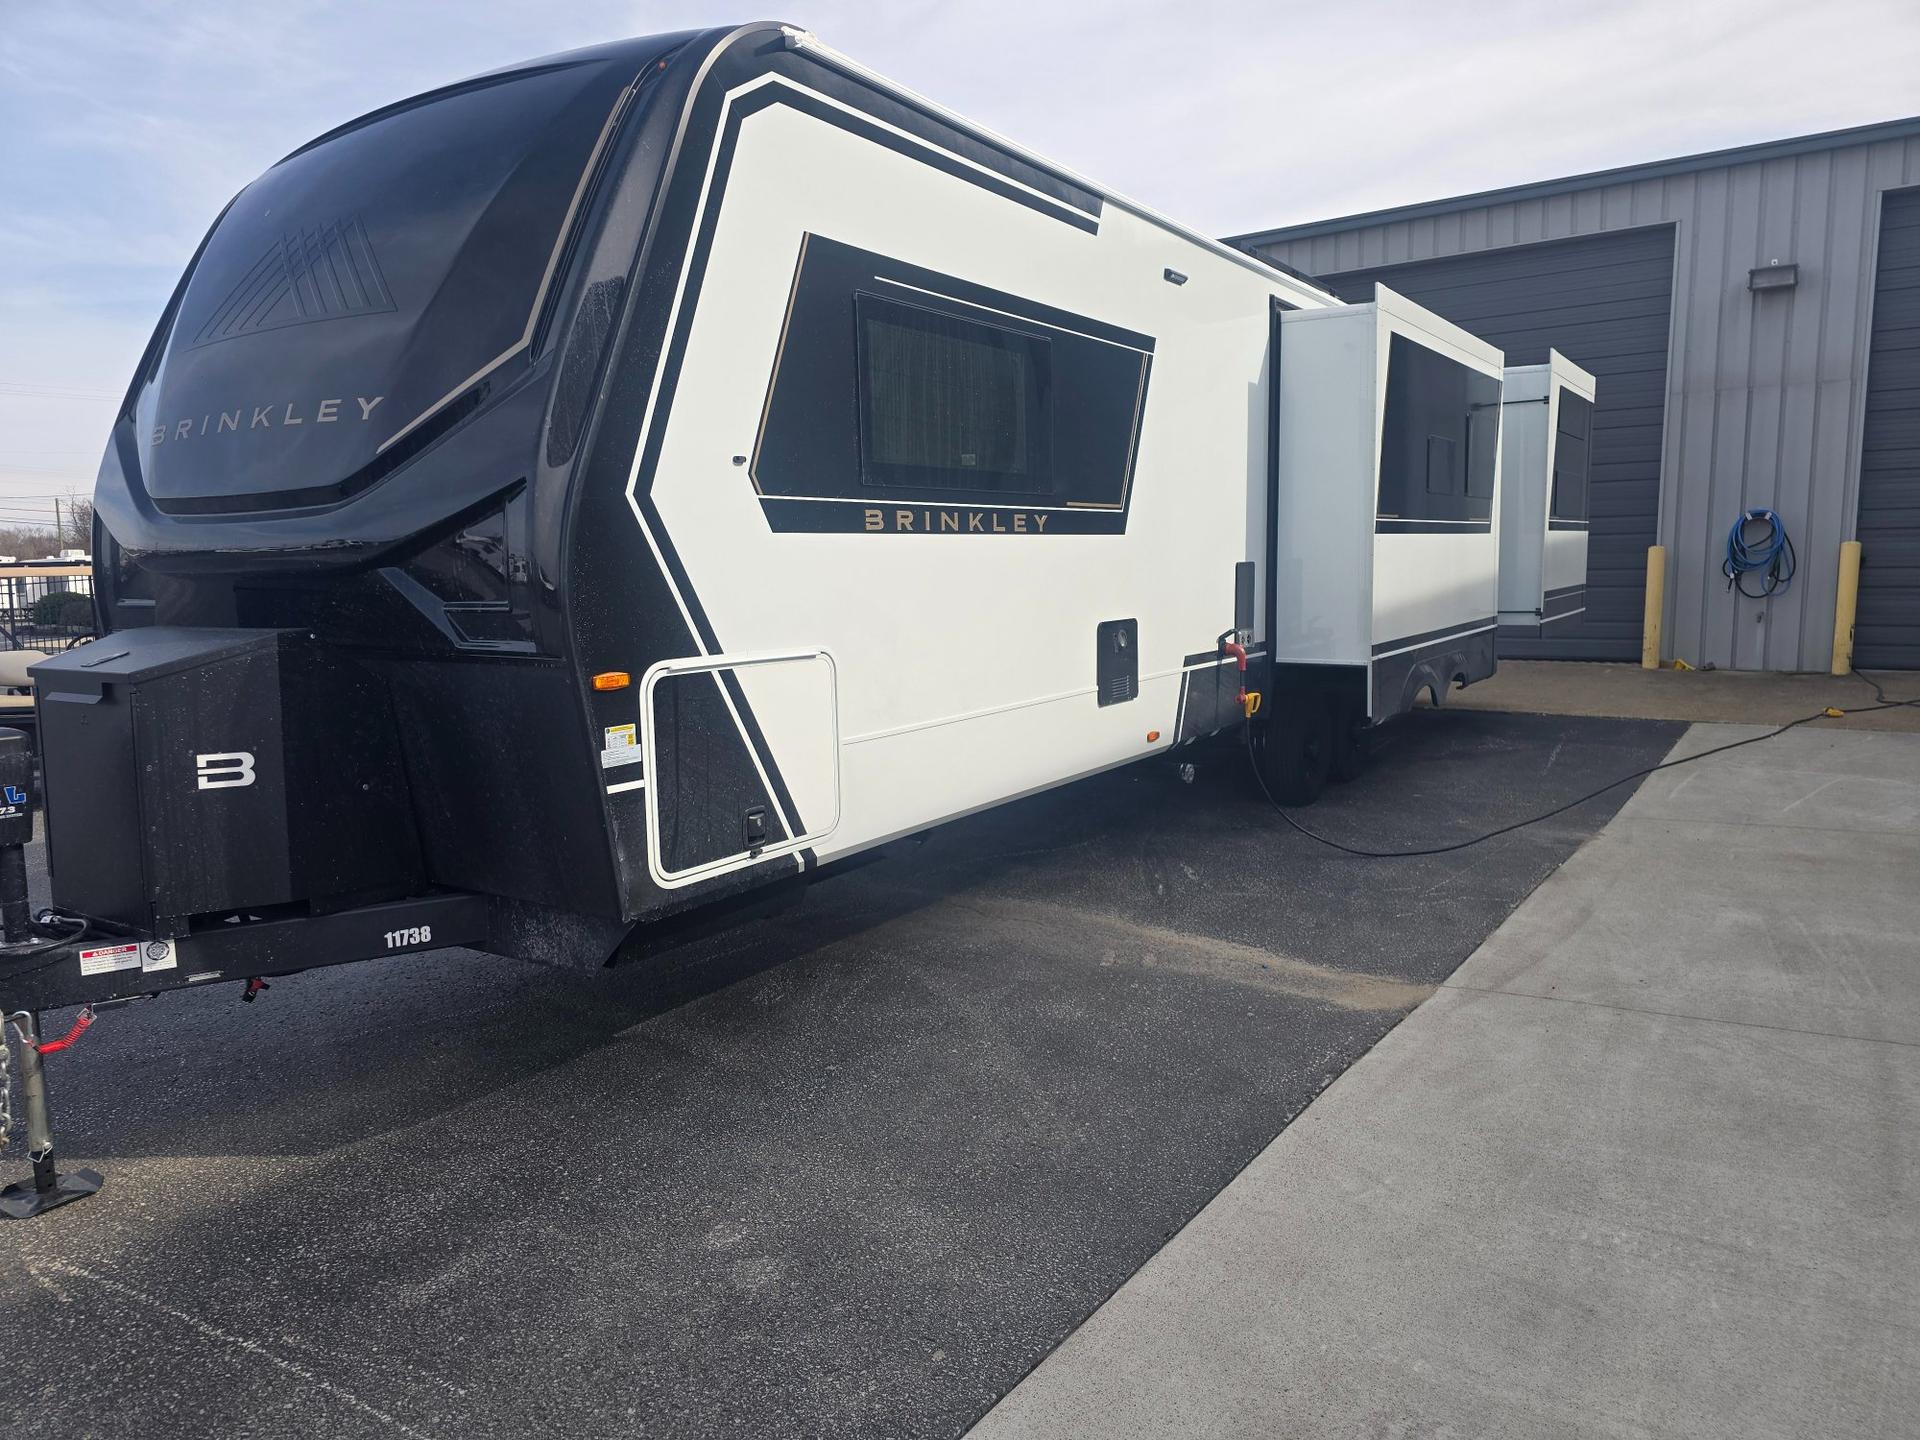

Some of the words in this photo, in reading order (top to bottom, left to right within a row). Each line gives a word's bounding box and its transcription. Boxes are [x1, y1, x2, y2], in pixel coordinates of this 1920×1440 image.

[151, 396, 385, 446] BRINKLEY
[864, 509, 1049, 533] BRINKLEY
[384, 925, 432, 949] 11738
